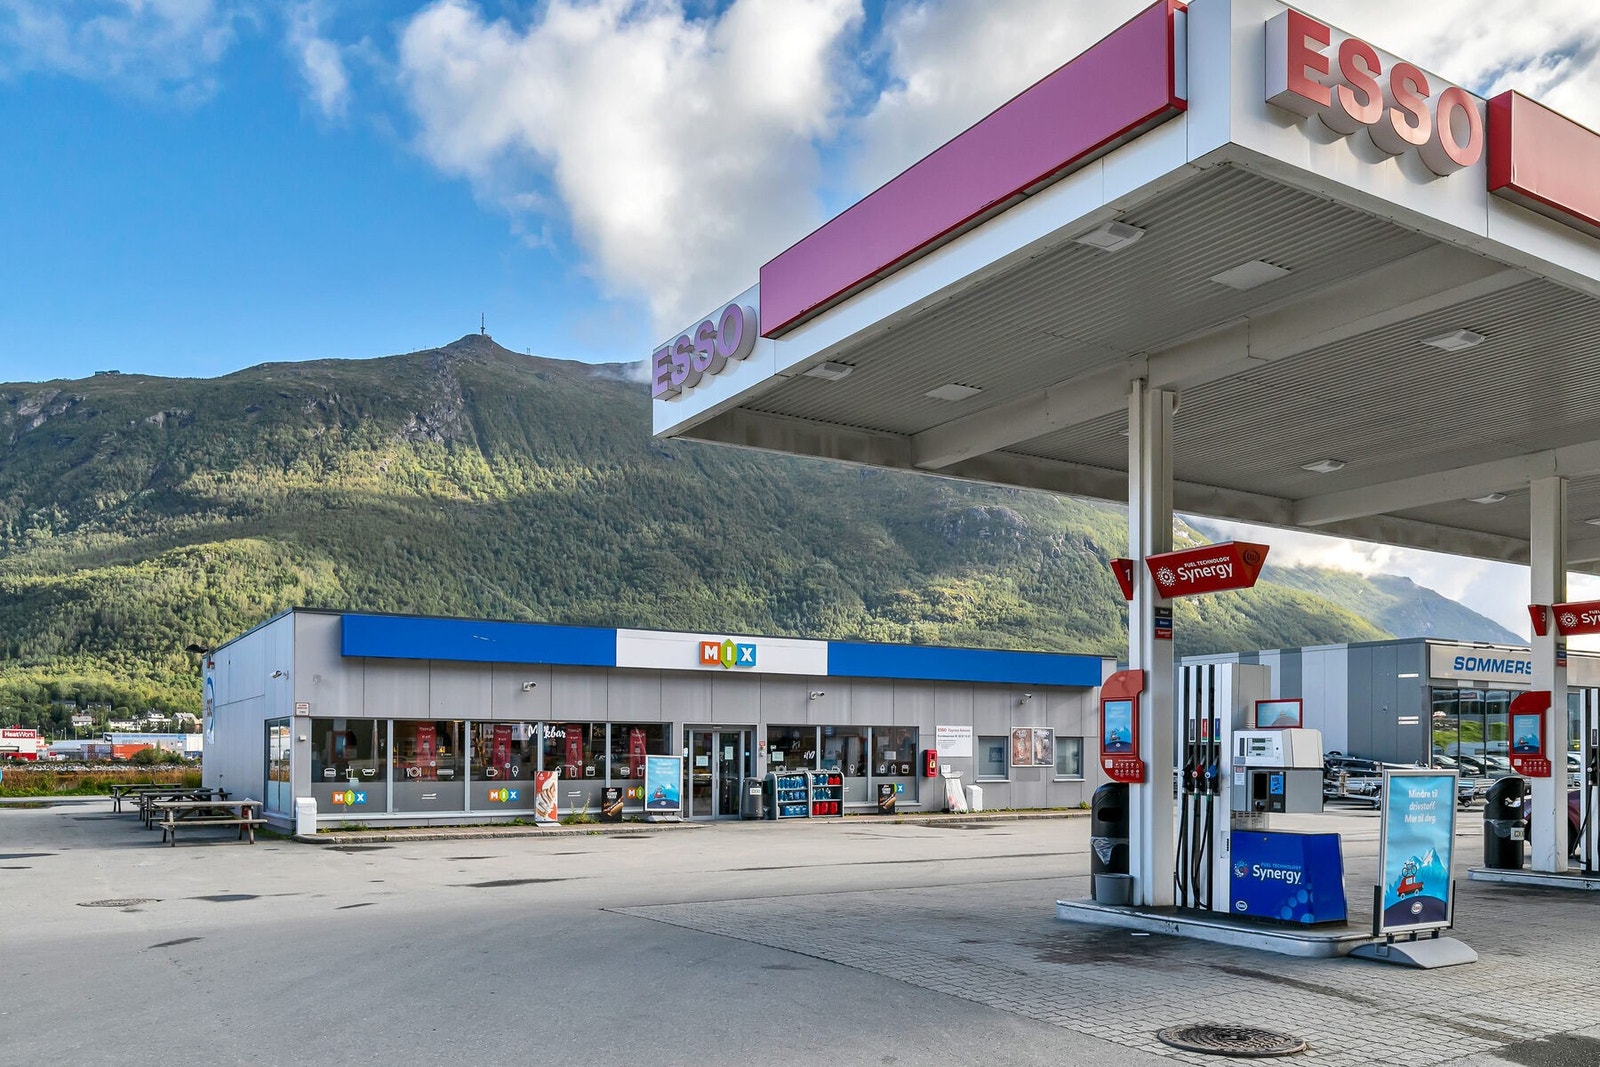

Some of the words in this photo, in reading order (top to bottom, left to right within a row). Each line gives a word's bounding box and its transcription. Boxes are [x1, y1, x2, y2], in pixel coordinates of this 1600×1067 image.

[1287, 8, 1484, 168] ESSO
[651, 303, 745, 399] ESSO
[1197, 556, 1230, 567] TECHNOLOGY
[1124, 568, 1131, 581] 1
[1177, 562, 1233, 583] Synergy
[703, 644, 753, 663] MIX
[1408, 789, 1431, 799] Mindre
[1252, 864, 1302, 885] Synergy
